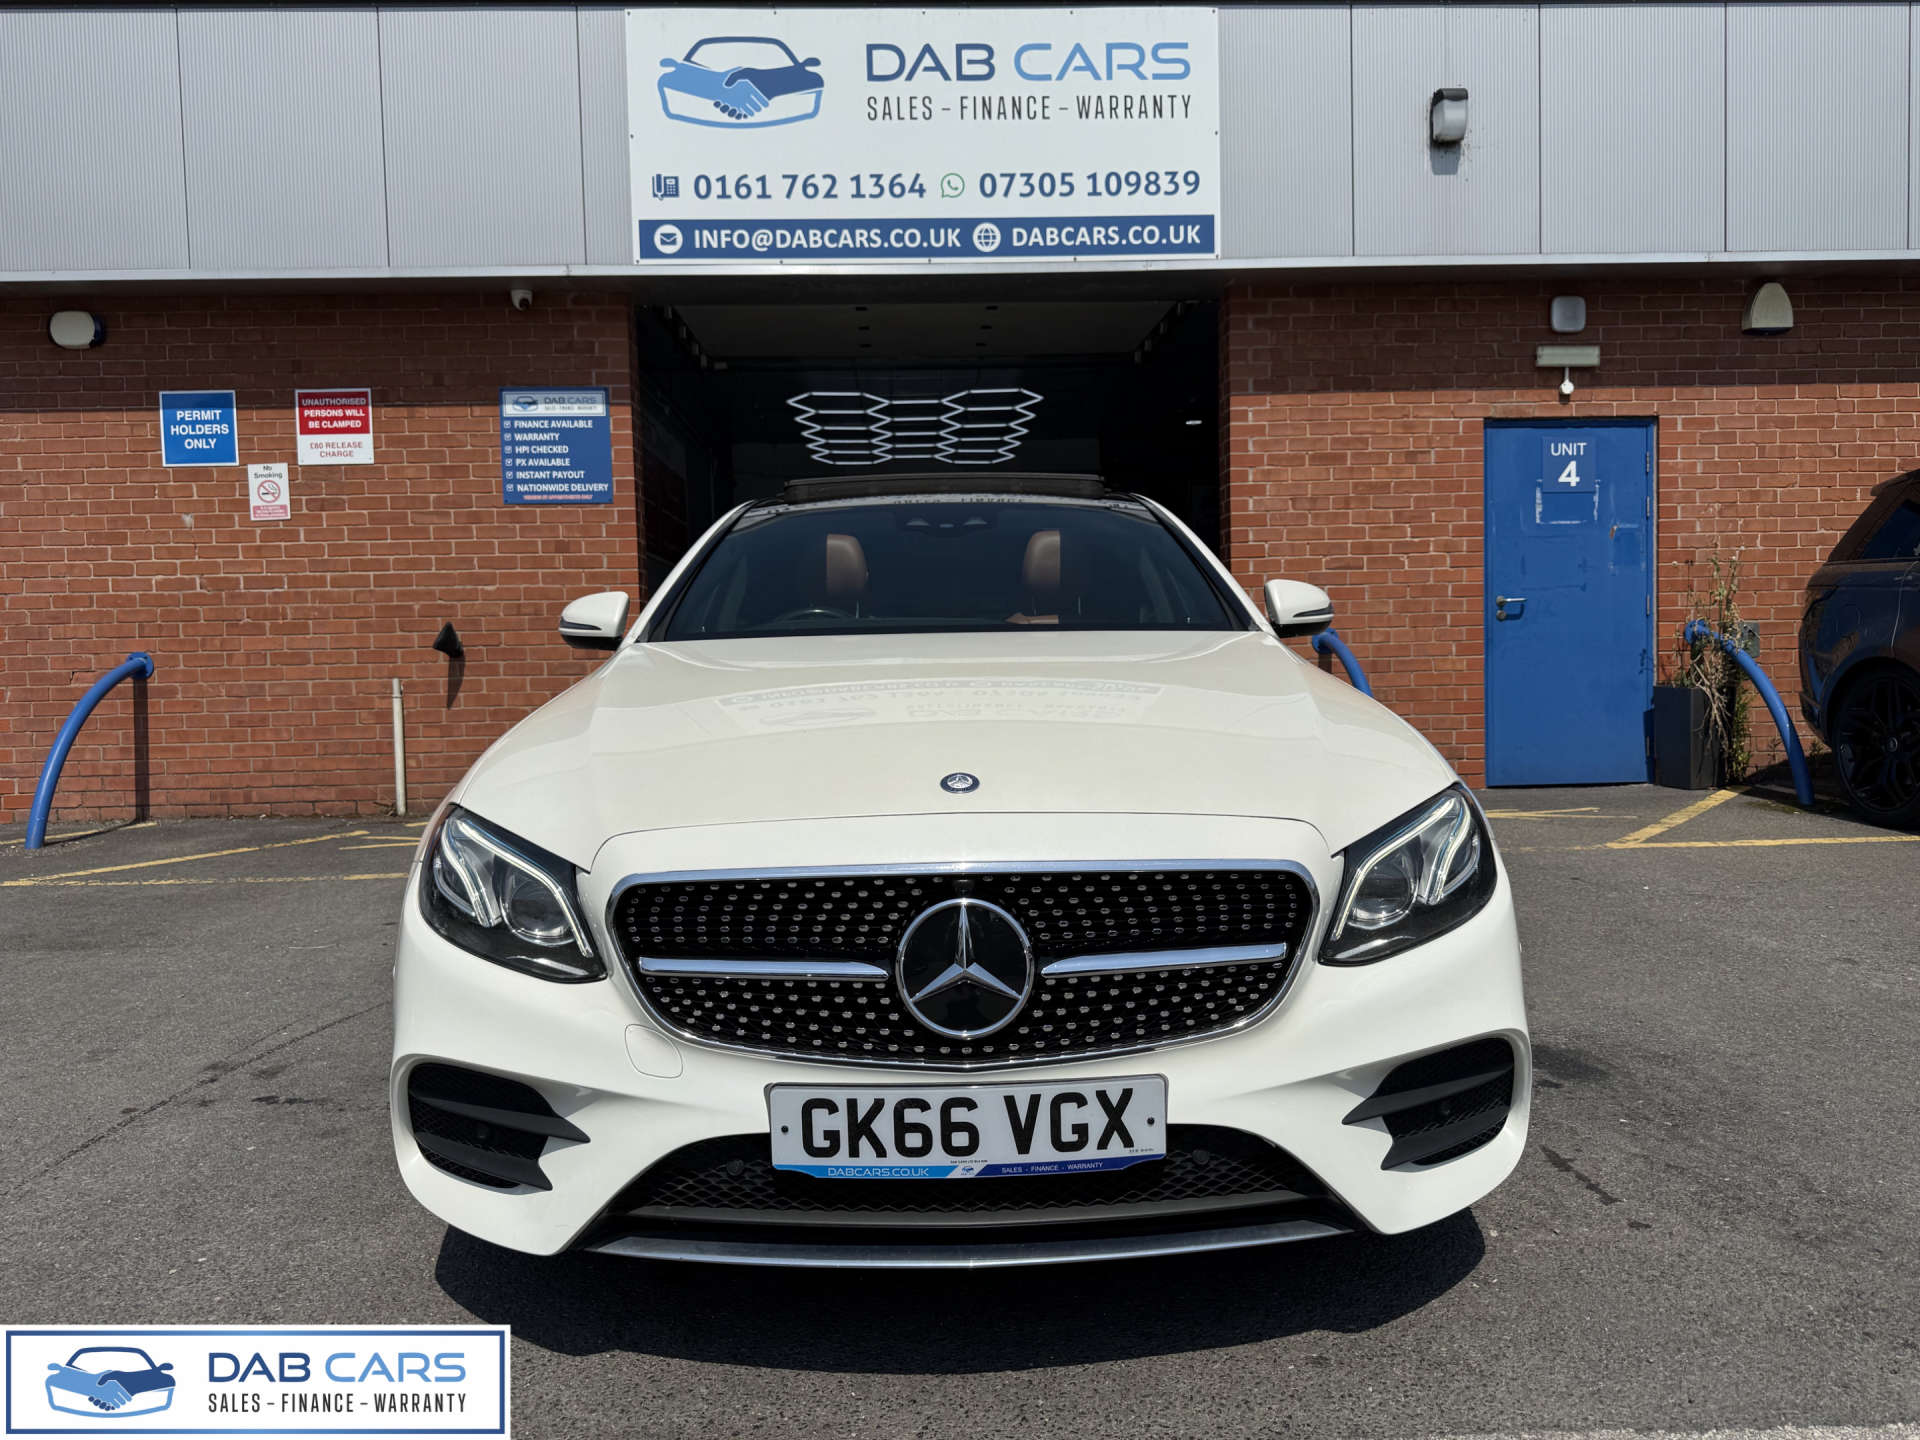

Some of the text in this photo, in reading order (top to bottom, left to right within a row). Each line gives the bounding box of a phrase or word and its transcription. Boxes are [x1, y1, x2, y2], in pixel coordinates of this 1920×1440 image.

[866, 42, 1192, 82] DAB CARS
[867, 96, 933, 121] SALES
[960, 95, 1051, 120] FINANCE
[1076, 94, 1192, 120] WARRANTY
[694, 172, 927, 200] 0161 762 1364
[979, 170, 1201, 198] 07305 109839
[694, 228, 961, 252] INFO@DABCARS.CO.UK
[1012, 224, 1201, 248] DABCARS.CO.UK
[301, 397, 367, 406] UNAUTHORISED
[176, 409, 222, 422] PERMIT
[303, 409, 366, 418] PERSONS WILL
[308, 420, 362, 429] BE CLAMPED
[514, 419, 593, 429] FINANCE AVAILABLE
[170, 424, 230, 436] HOLDERS
[514, 433, 560, 441] WARRANTY
[184, 438, 217, 450] ONLY
[325, 441, 363, 450] RELEASE
[515, 445, 569, 454] HPI CHECKED
[1550, 442, 1588, 457] UNIT
[319, 450, 354, 458] CHARGE
[516, 458, 571, 467] PX AVAILABLE
[253, 472, 283, 480] Smoking
[516, 470, 585, 479] INSTANT PAYOUT
[1557, 460, 1581, 487] 4
[517, 483, 609, 492] NATIONWIDE DELIVERY
[801, 1087, 1135, 1159] GK66 VGX
[827, 1167, 930, 1178] DABCARS.CO.UK
[1001, 1166, 1024, 1174] SALES
[1031, 1164, 1060, 1173] FINANCE
[1067, 1161, 1104, 1171] WARRANTY
